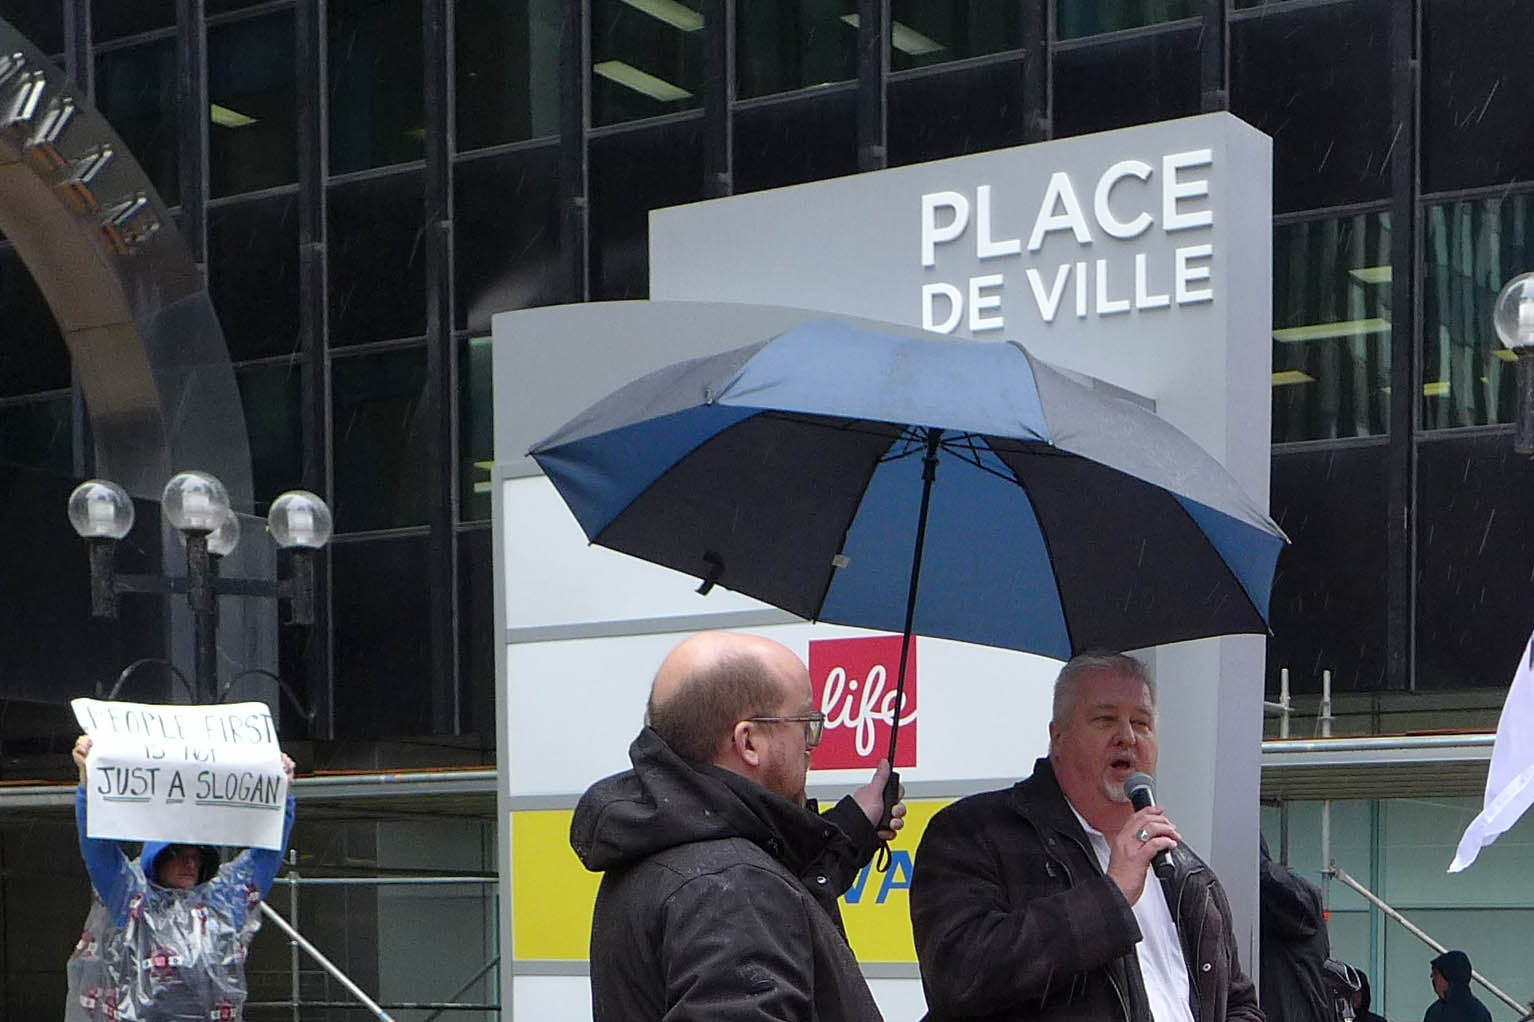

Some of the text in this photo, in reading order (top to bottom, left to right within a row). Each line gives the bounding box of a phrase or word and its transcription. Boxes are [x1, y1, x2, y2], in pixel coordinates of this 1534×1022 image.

[921, 149, 1213, 267] PLACE
[922, 244, 1214, 334] DE VILLE
[205, 714, 273, 744] FIRST
[823, 665, 917, 757] life
[97, 767, 280, 804] JUST A SLOGAN
